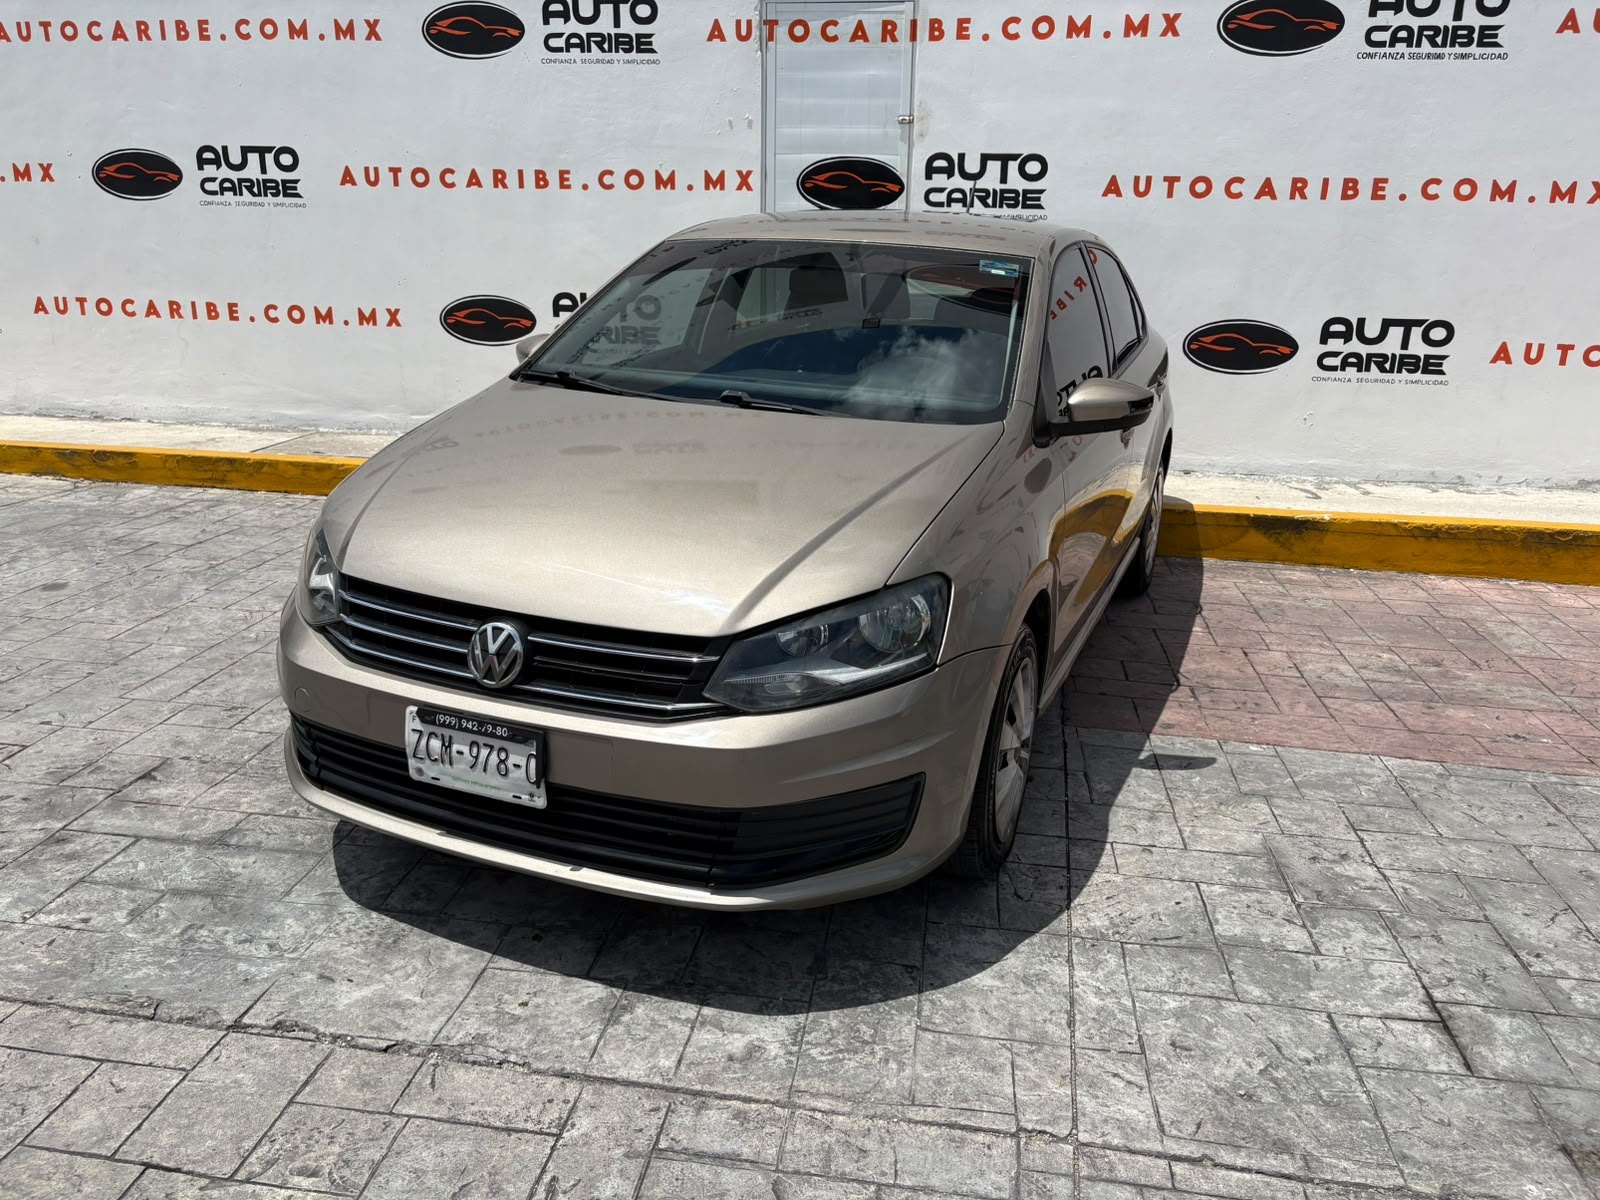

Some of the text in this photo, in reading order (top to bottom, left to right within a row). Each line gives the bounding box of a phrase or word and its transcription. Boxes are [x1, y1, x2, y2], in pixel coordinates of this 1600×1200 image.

[541, 0, 659, 29] AUTO
[0, 18, 382, 43] AUTOCARIBE.COM.MX
[707, 13, 1183, 43] AUTOCARIBE.COM.MX
[1364, 24, 1505, 49] CARIBE
[543, 32, 659, 54] CARIBE
[540, 57, 578, 65] CONFIANZA
[622, 58, 661, 66] SIMPLICIDAD
[1356, 51, 1406, 61] CONFIANZA
[1407, 52, 1446, 61] SEGURIDAD
[195, 144, 300, 175] AUTO
[924, 151, 1049, 184] AUTO
[199, 176, 304, 199] CARIBE
[339, 165, 754, 192] AUTOCARIBE.COM.MX
[199, 199, 233, 207] CONFIANZA
[272, 201, 307, 209] SIMPLICIDAD
[924, 187, 1047, 210] CARIBE
[33, 296, 402, 327] AUTOCARIBE.COM.MX
[1319, 316, 1455, 349] AUTO
[1316, 350, 1451, 375] CARIBE
[1311, 375, 1352, 384] CONFIANZA
[1355, 377, 1397, 386] SEGURIDAD
[1404, 379, 1450, 387] SIMPLICIDAD
[435, 713, 460, 729] (999)
